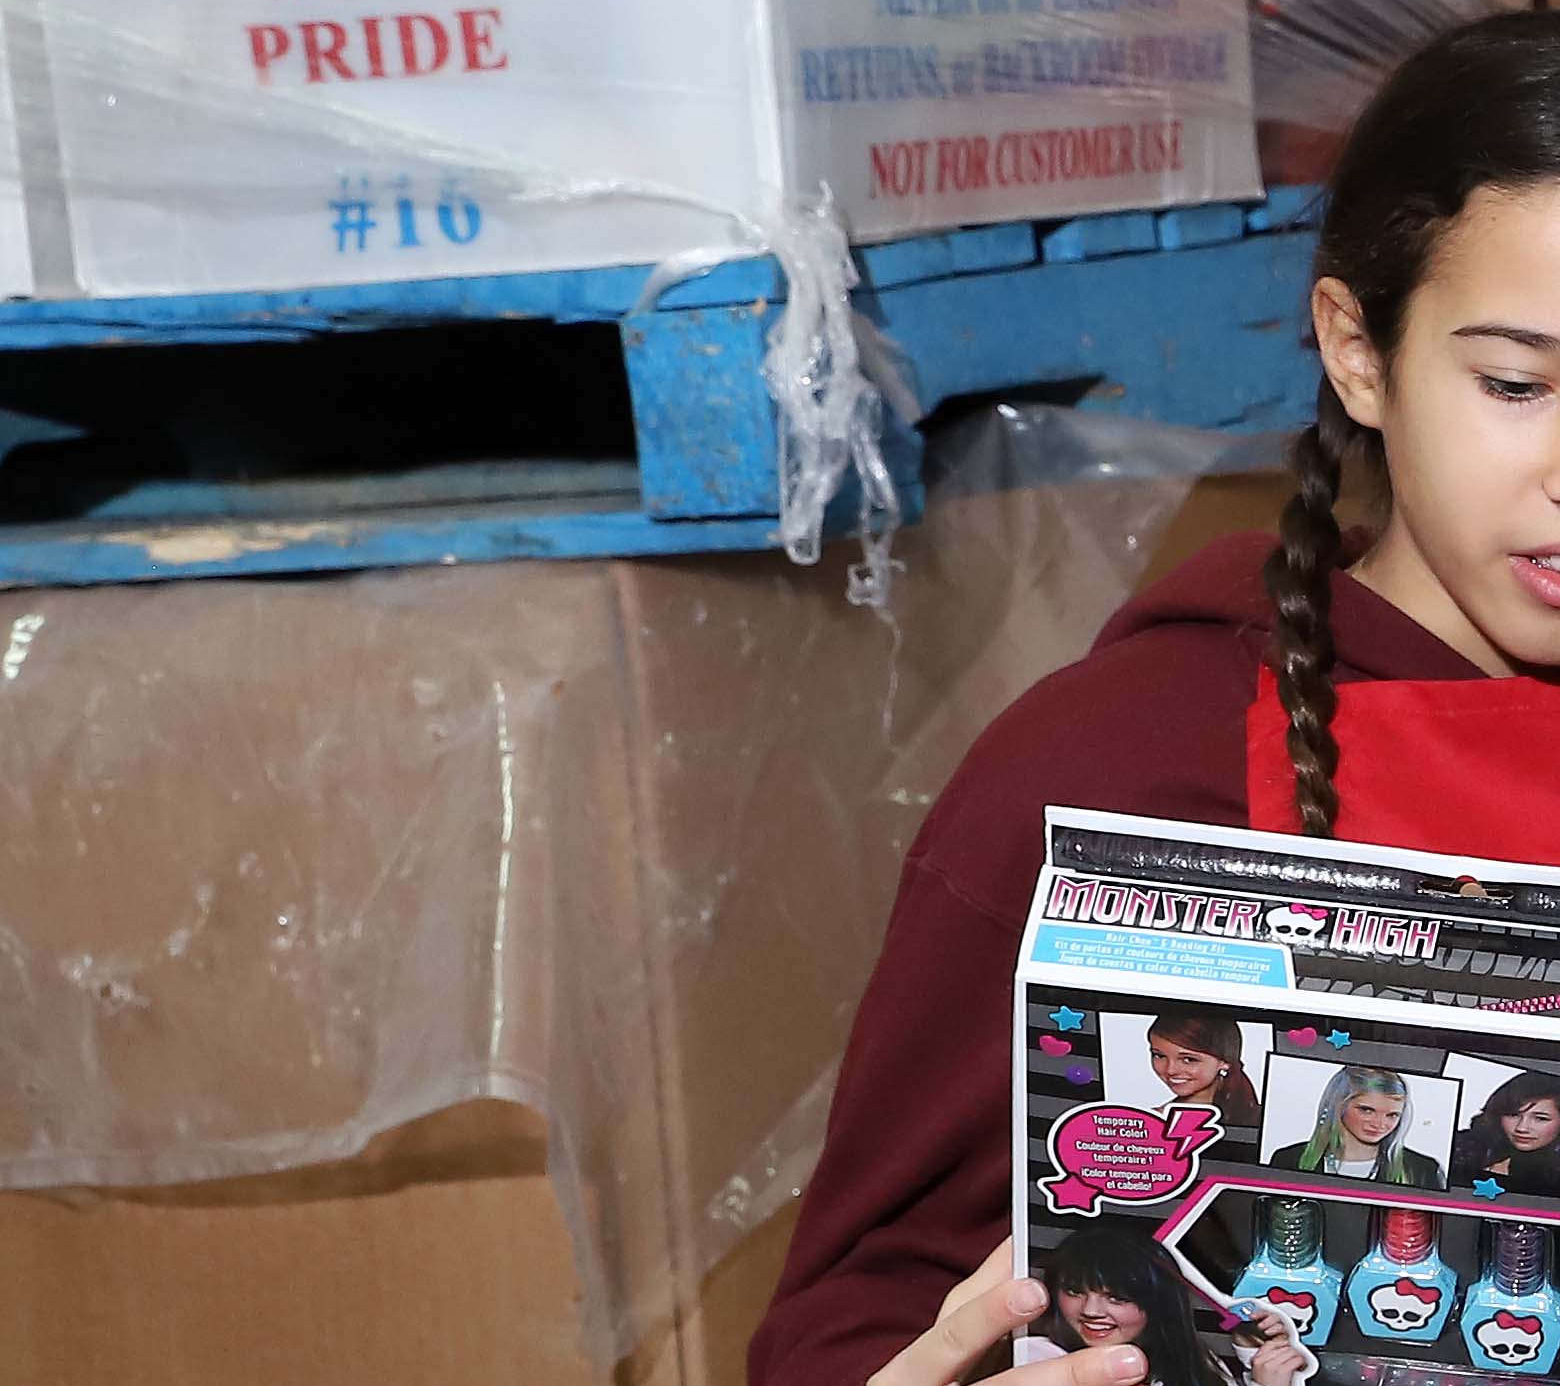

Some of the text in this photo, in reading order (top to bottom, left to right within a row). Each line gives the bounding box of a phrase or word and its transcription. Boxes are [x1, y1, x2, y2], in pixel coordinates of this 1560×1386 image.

[245, 9, 509, 90] PRIDE
[869, 139, 930, 200] NOT
[936, 135, 989, 194] FOR
[994, 124, 1135, 188] CUSTOMER
[1044, 875, 1442, 961] MONSTER HIGH
[1093, 1115, 1144, 1128] Temporary
